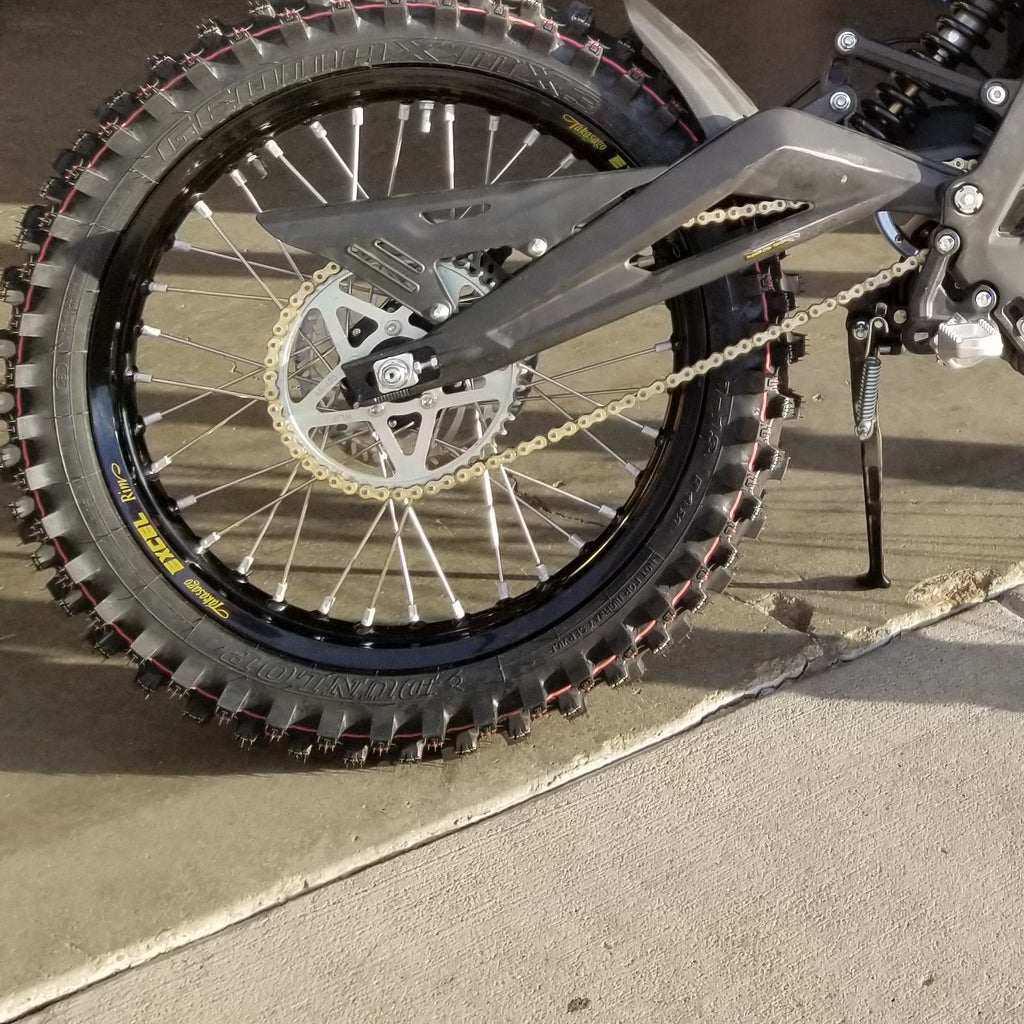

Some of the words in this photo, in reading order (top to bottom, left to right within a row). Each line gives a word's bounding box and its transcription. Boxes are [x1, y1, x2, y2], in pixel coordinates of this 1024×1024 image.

[562, 113, 608, 151] Takasago
[111, 462, 137, 503] Rim
[132, 512, 185, 576] EXCEL
[183, 578, 230, 619] Takasago
[219, 647, 442, 705] DUNLOP
